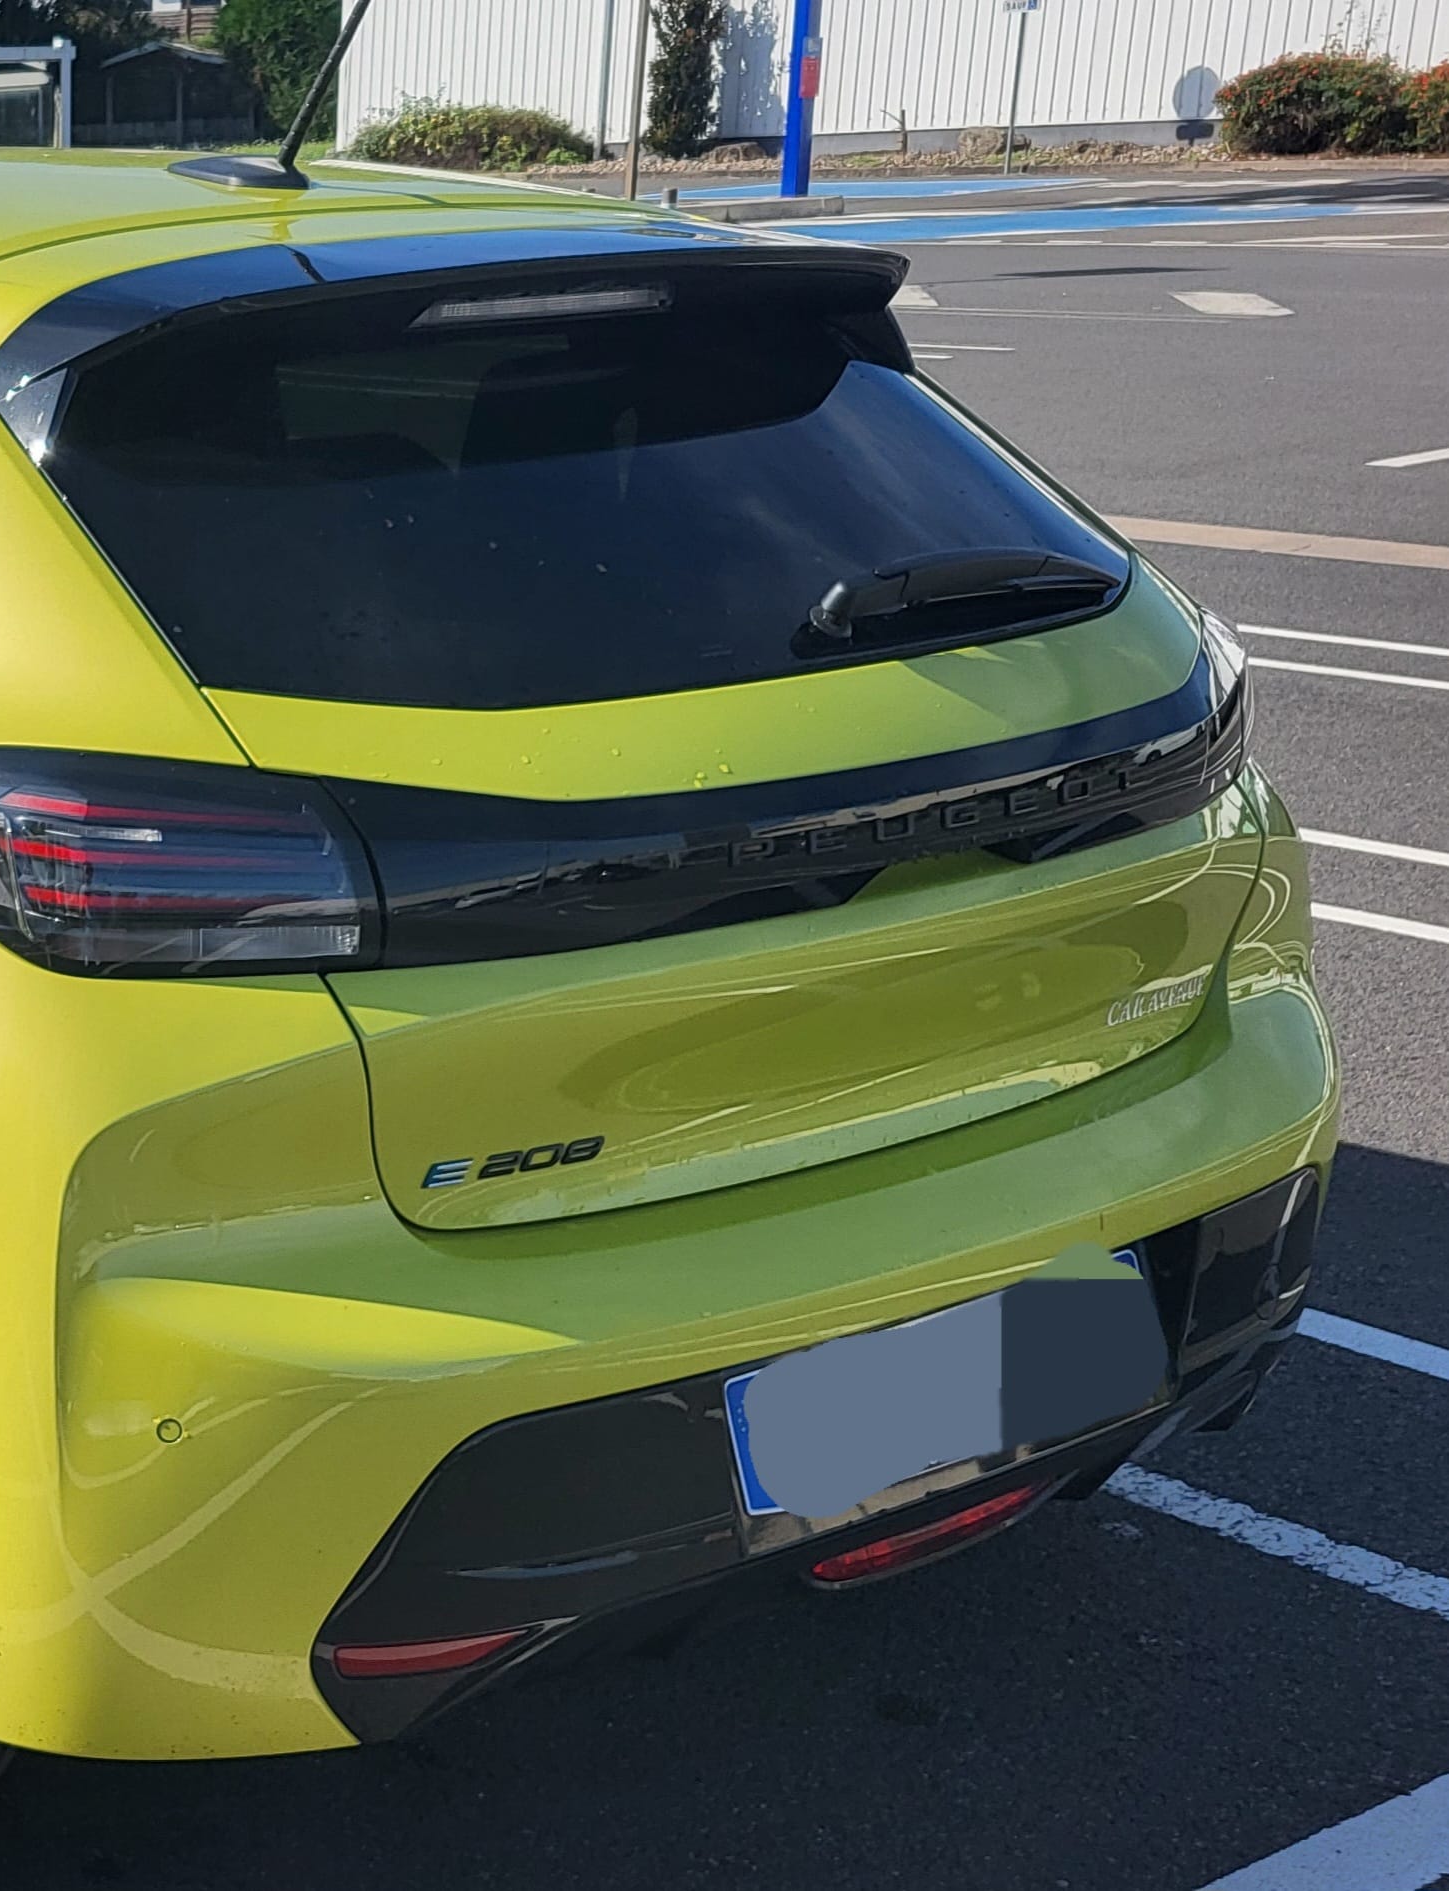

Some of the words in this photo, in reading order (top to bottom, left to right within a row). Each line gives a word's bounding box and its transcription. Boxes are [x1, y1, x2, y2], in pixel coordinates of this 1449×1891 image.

[729, 767, 1133, 867] PEUGEOT
[421, 1157, 474, 1189] E
[477, 1135, 606, 1180] 208
